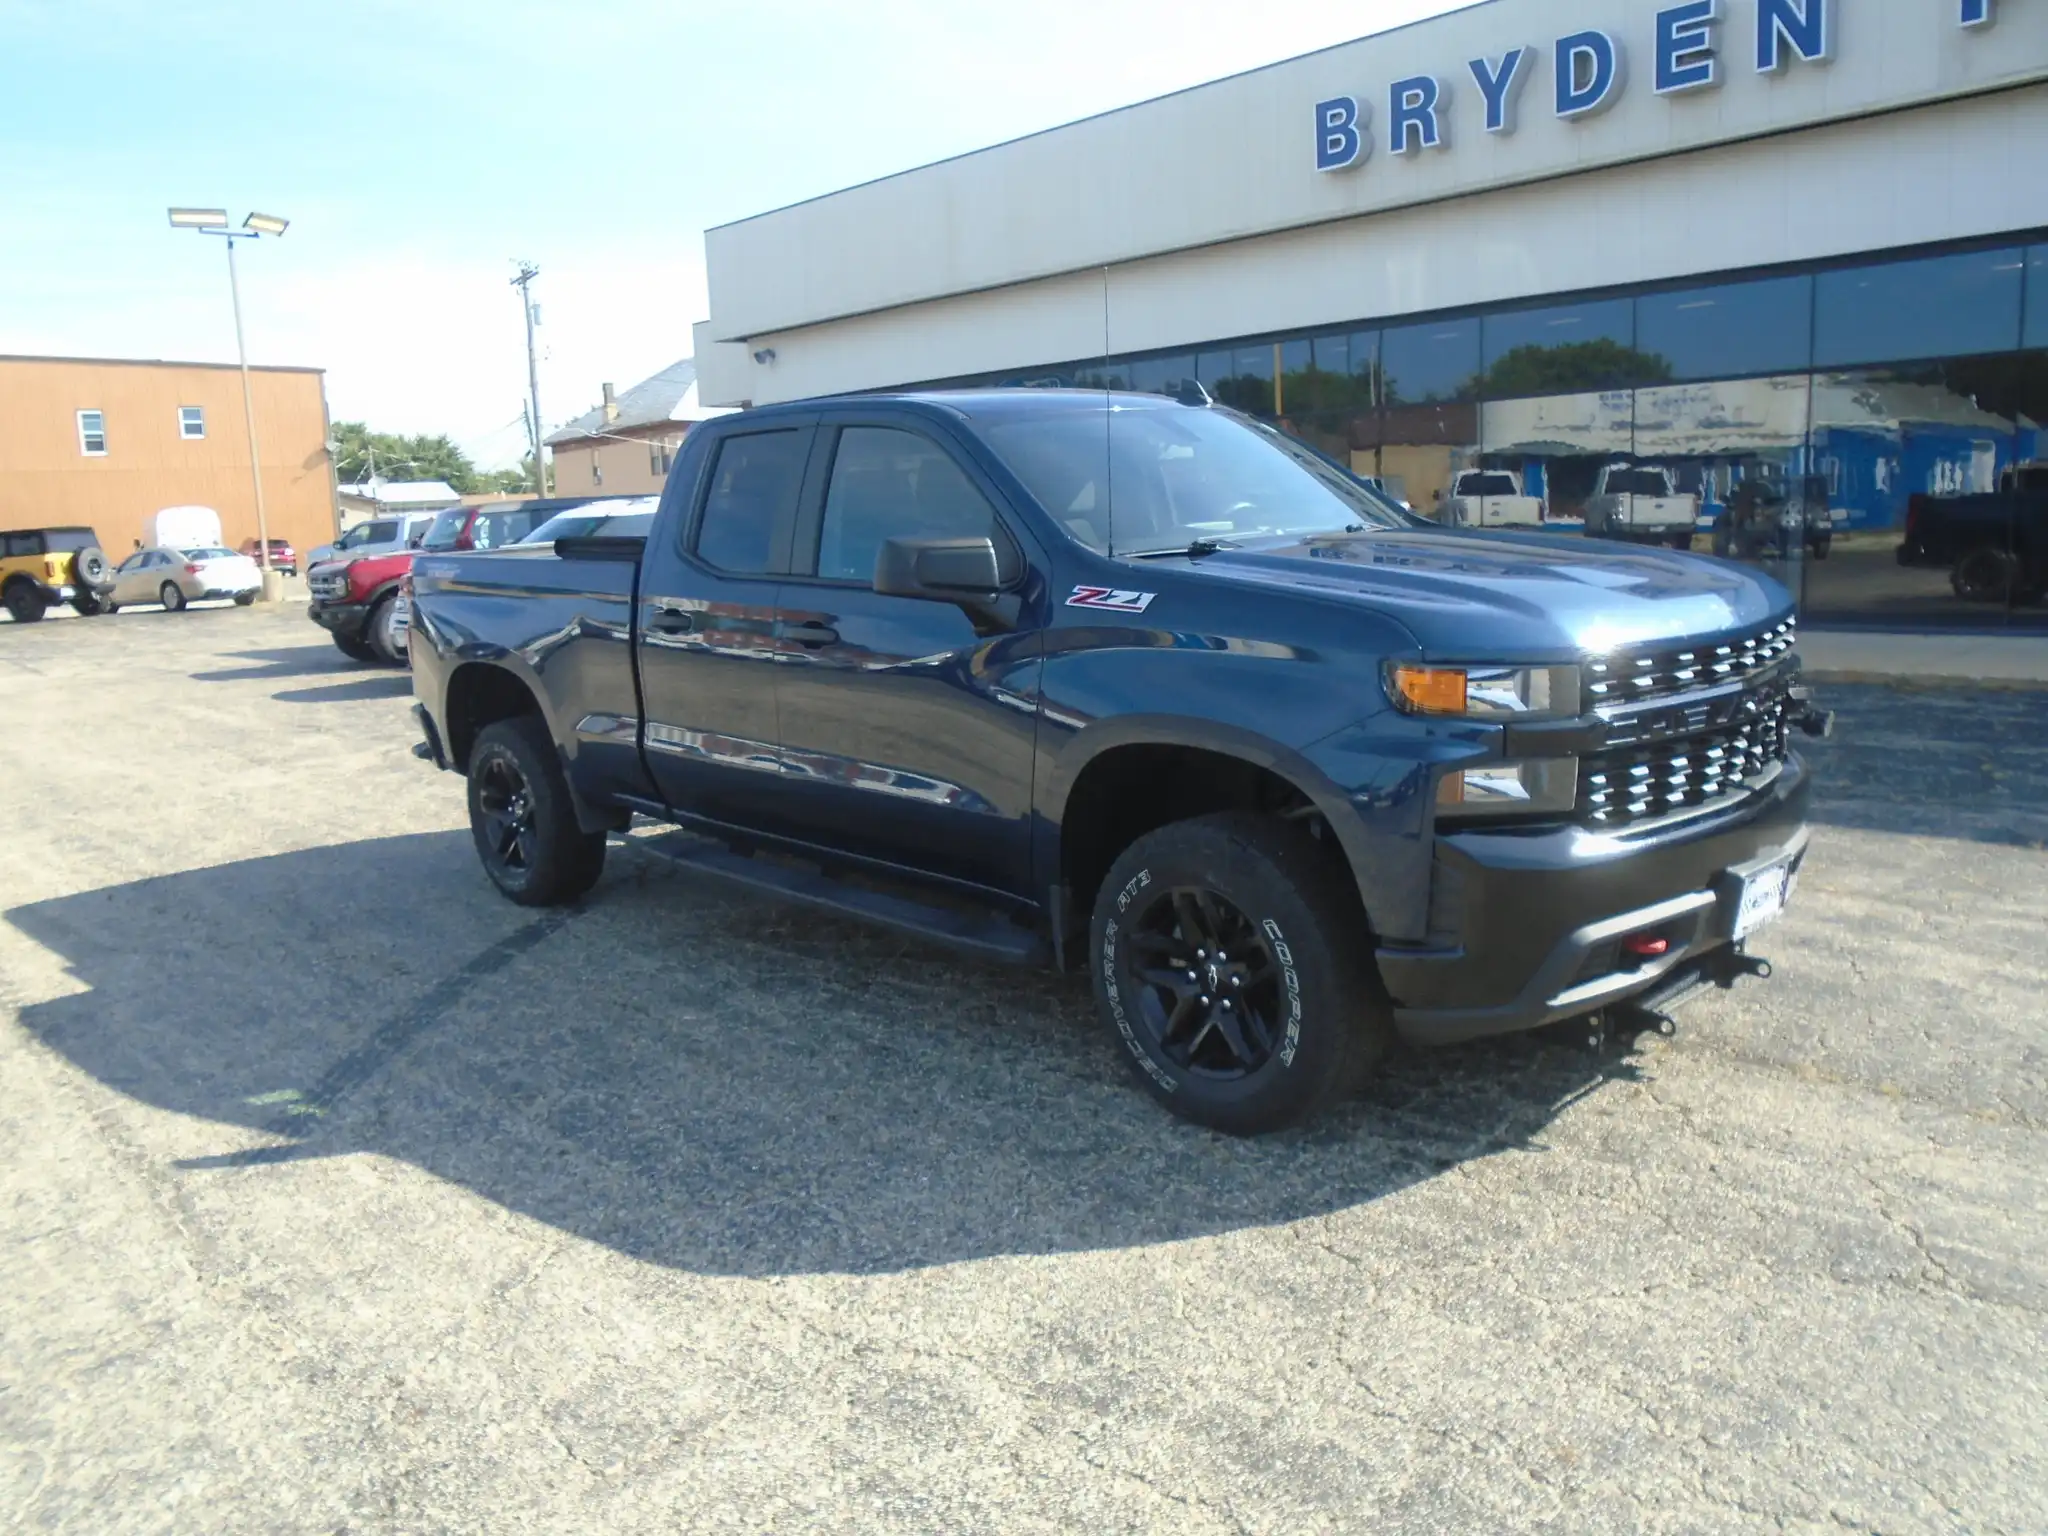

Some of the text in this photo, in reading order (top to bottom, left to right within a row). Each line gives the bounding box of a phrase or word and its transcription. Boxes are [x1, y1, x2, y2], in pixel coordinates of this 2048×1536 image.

[1315, 0, 1830, 172] BRYDEN
[1064, 585, 1158, 613] Z71
[1117, 868, 1152, 913] AT3
[1262, 919, 1302, 1068] COOPER
